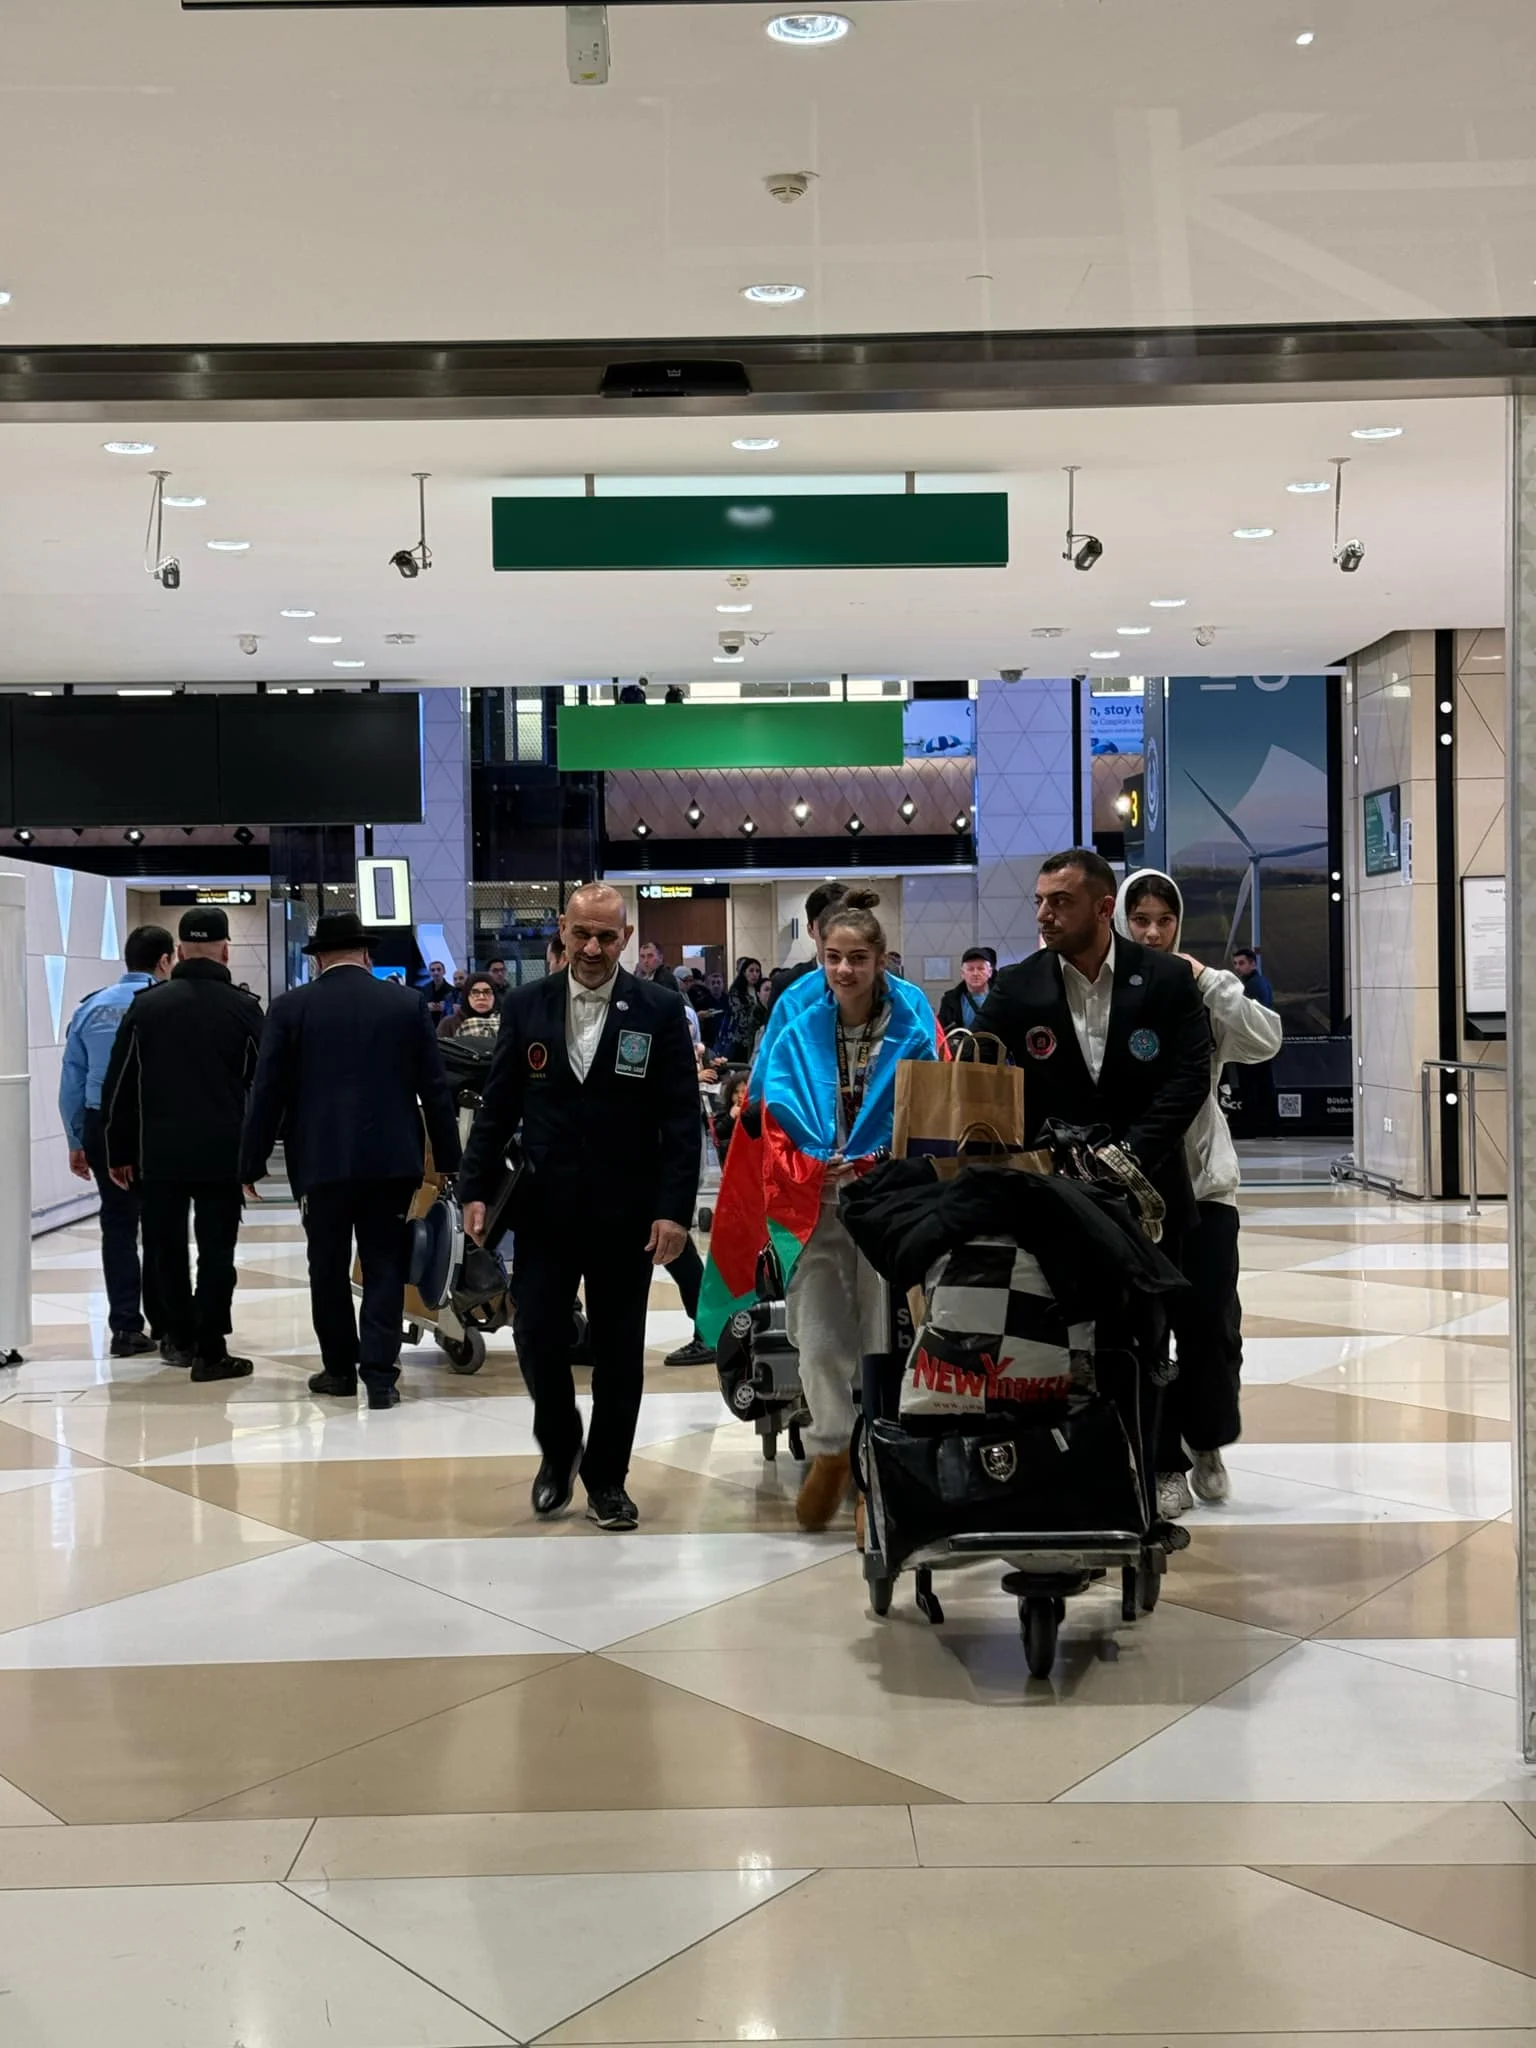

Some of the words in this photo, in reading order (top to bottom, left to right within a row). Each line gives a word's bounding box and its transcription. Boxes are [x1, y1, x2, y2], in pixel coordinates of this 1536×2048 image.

[1104, 705, 1132, 717] stay
[1100, 717, 1131, 726] Caspian
[1131, 790, 1139, 827] 3
